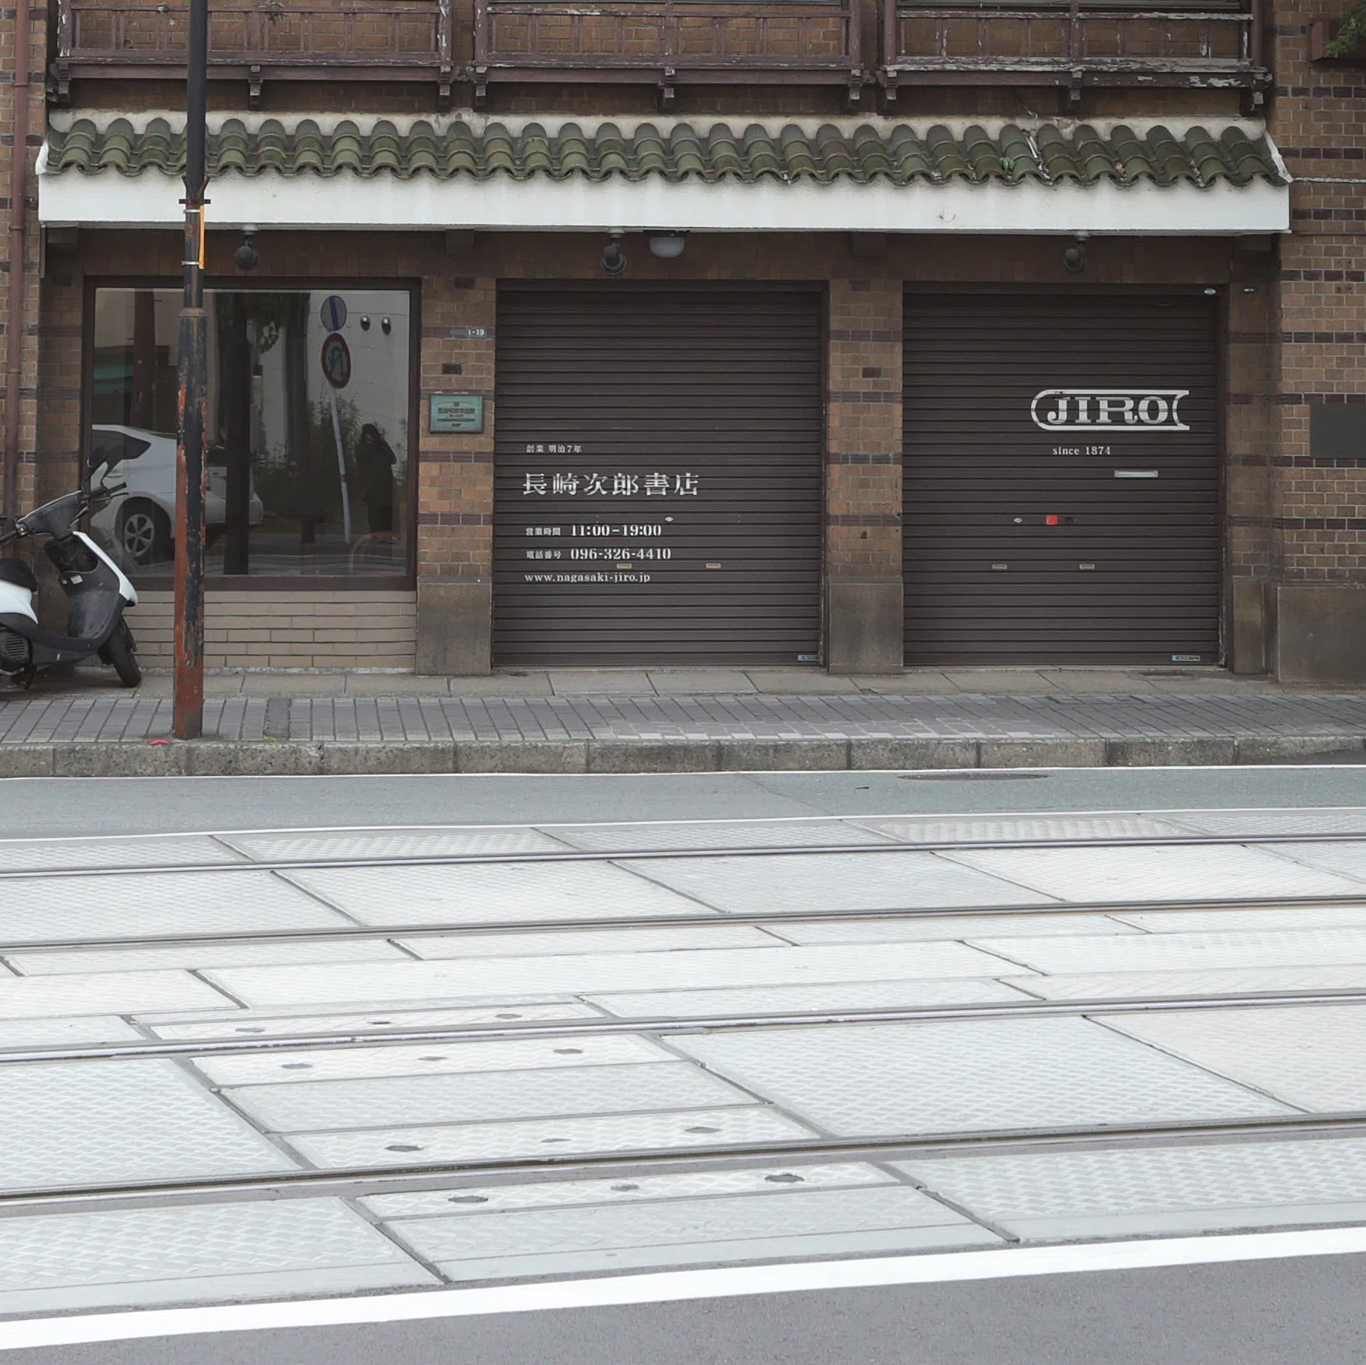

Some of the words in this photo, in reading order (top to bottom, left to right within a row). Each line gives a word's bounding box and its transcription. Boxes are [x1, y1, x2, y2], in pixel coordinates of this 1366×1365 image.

[1046, 396, 1169, 424] JIRO
[526, 444, 544, 453] 創業
[548, 444, 582, 453] 明治7年
[1052, 446, 1080, 455] since
[1085, 446, 1111, 455] 1874
[522, 472, 699, 496] 長崎次郎書店
[525, 527, 561, 536] 営業時間
[526, 550, 561, 560] 電話番号
[570, 548, 671, 560] 096-326-4410
[524, 572, 651, 583] www.nagasaki-jiro.jp
